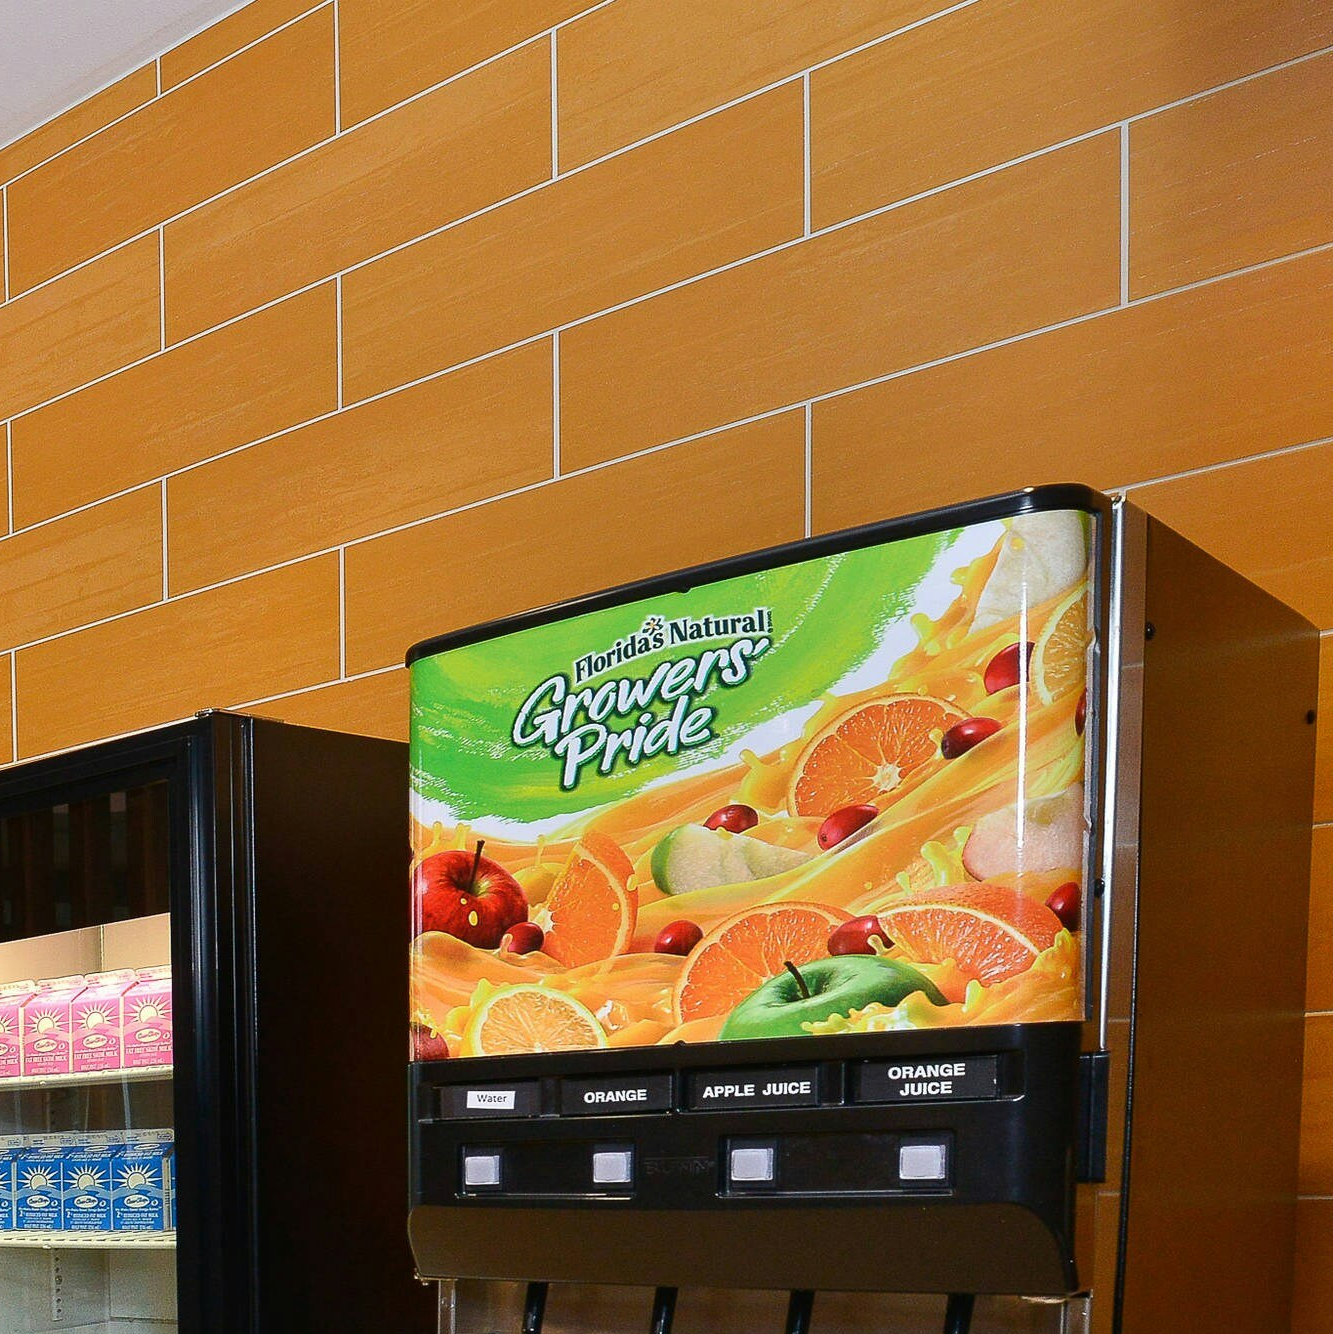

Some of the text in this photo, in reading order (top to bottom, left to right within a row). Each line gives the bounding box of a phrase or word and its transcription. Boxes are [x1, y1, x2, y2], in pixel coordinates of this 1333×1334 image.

[670, 608, 766, 645] Natural
[554, 694, 715, 790] Pride
[887, 1062, 966, 1080] ORANGE
[583, 1088, 647, 1104] ORANGE
[702, 1081, 812, 1098] APPLE JUICE
[899, 1080, 953, 1096] JUICE
[476, 1093, 508, 1103] Water
